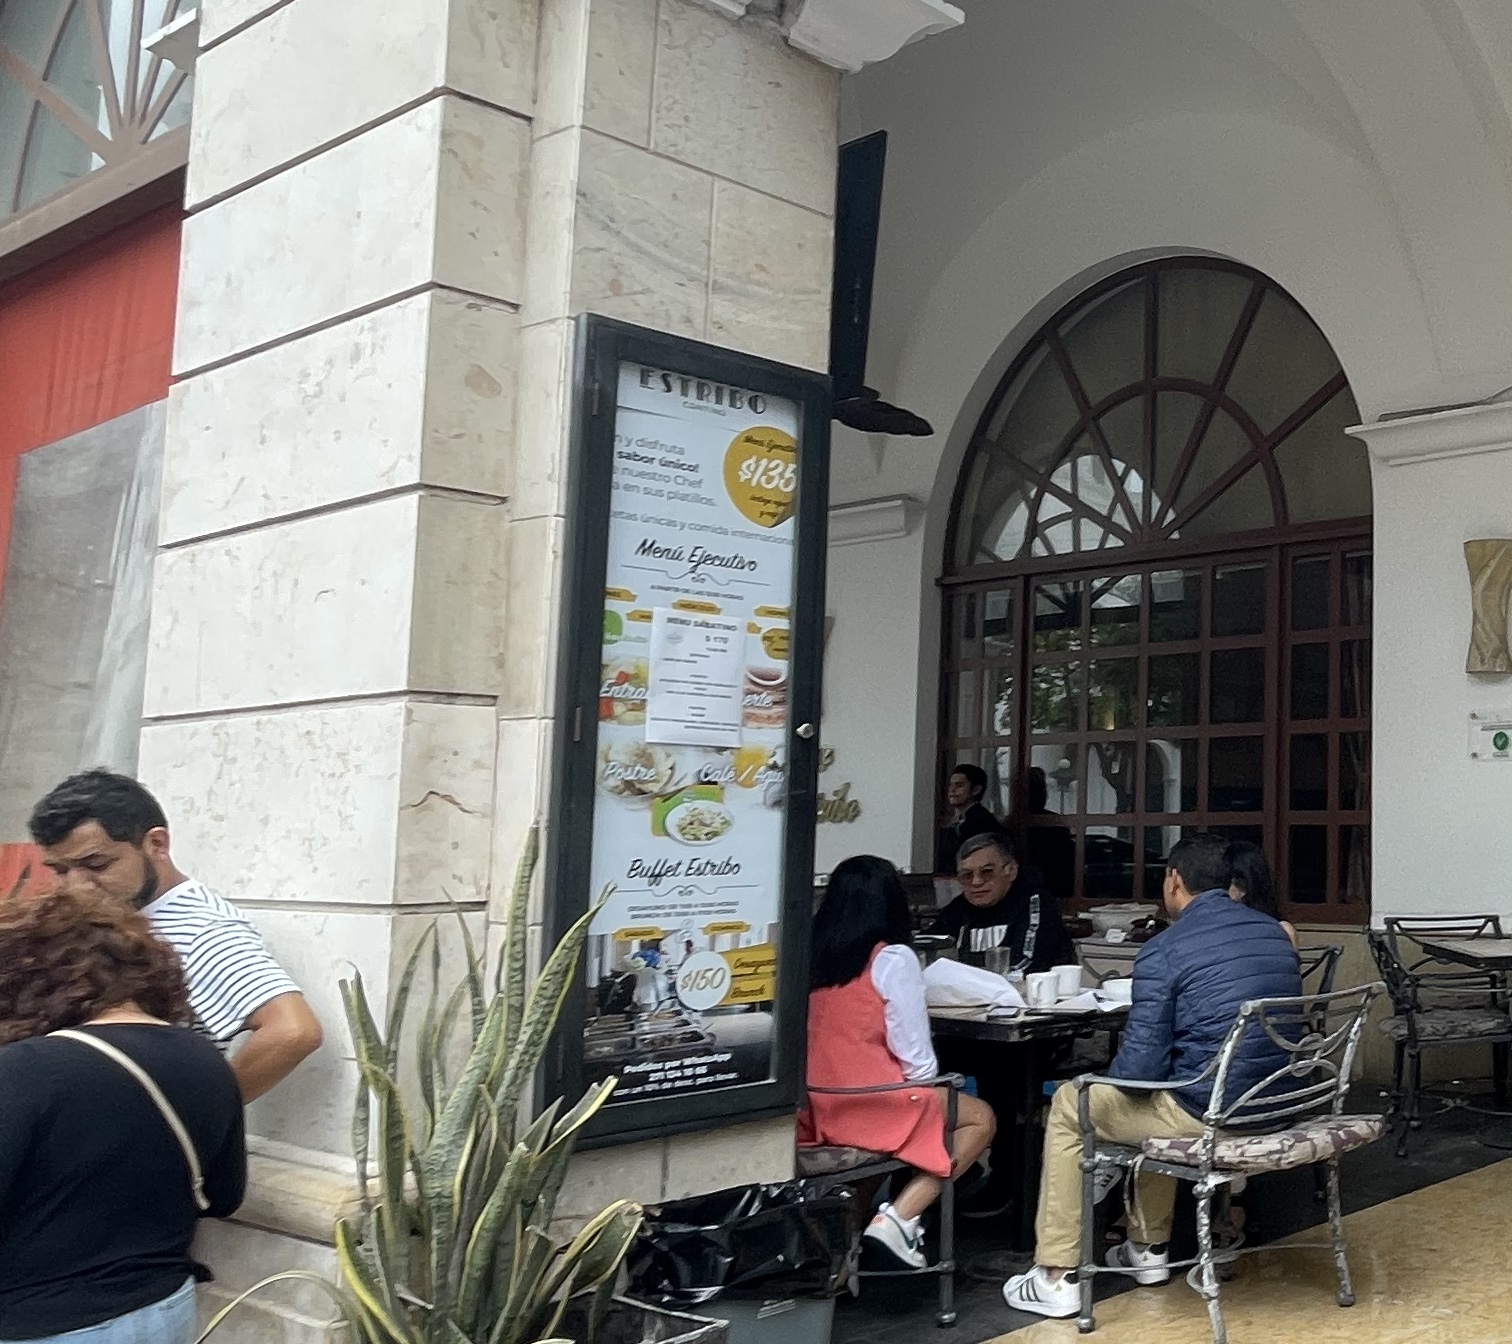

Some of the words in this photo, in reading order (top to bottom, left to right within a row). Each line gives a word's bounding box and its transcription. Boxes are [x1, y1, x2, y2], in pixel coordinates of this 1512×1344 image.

[639, 367, 768, 415] ESTRIBO
[624, 435, 633, 447] y
[635, 433, 686, 455] disfruta
[616, 450, 656, 466] sabor
[658, 455, 700, 474] único!
[738, 455, 798, 493] $135
[621, 466, 671, 484] nuestro
[674, 473, 704, 488] Chef
[623, 482, 641, 494] en
[643, 486, 665, 499] sus
[640, 512, 678, 529] únicas
[678, 520, 687, 531] y
[688, 521, 729, 536] comida
[634, 538, 686, 562] Menú
[687, 545, 758, 574] Ejecutivo
[600, 679, 649, 700] Entra
[604, 761, 658, 781] Postre
[700, 763, 736, 782] Café
[626, 858, 682, 887] Buffet
[684, 855, 742, 878] Estribo
[680, 967, 726, 993] $150
